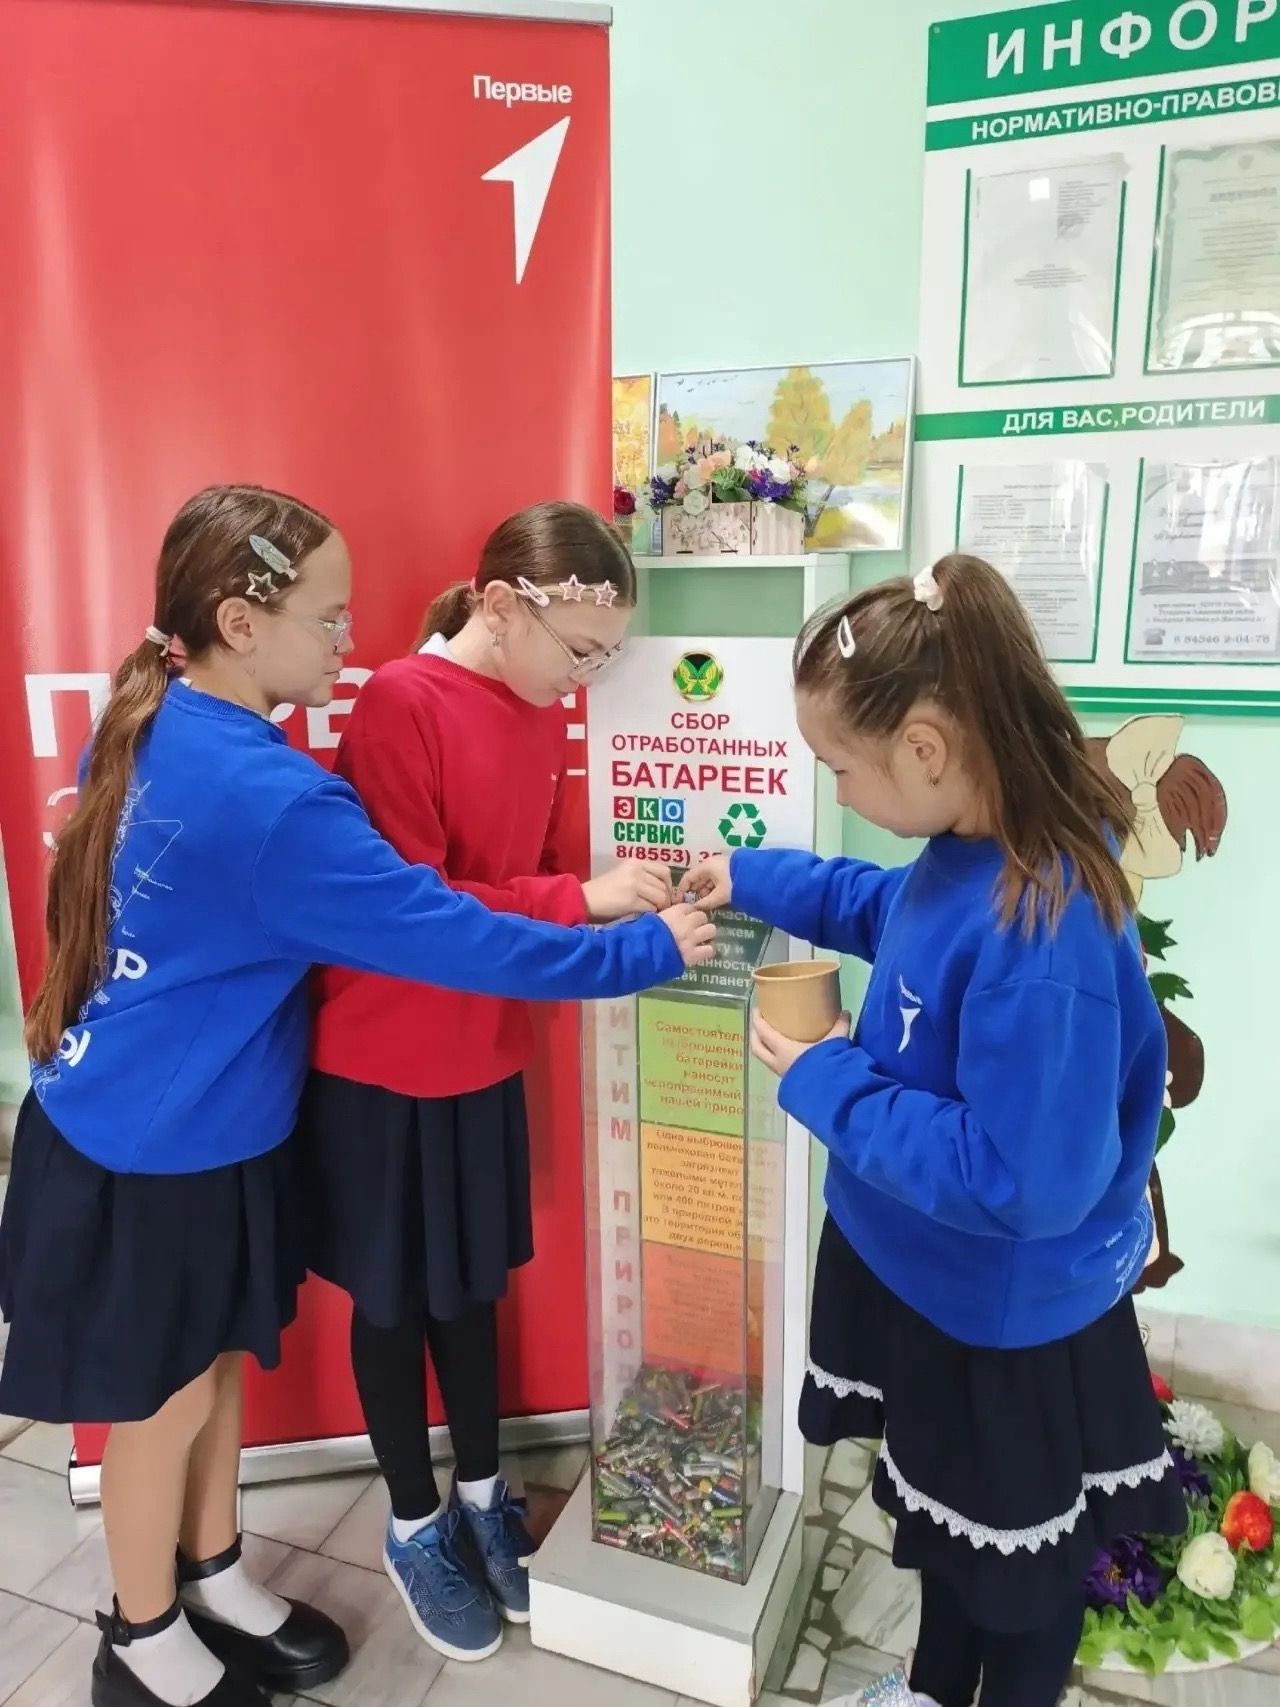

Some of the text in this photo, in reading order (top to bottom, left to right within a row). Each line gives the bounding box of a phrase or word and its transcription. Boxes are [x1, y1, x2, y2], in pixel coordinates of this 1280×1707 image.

[473, 75, 572, 108] Первые
[971, 81, 1280, 140] НОРМАТИВНО-ПРАВОВ
[1002, 411, 1054, 434] ДЛЯ
[671, 712, 730, 730] СБОР
[611, 734, 788, 758] ОТРАБОТАННЫХ
[611, 760, 788, 795] БАТАРЕЕК
[615, 797, 683, 822] ЭКО
[613, 821, 684, 846] СЕРВИС
[701, 973, 751, 988] планет
[609, 1003, 633, 1143] ИТИМ
